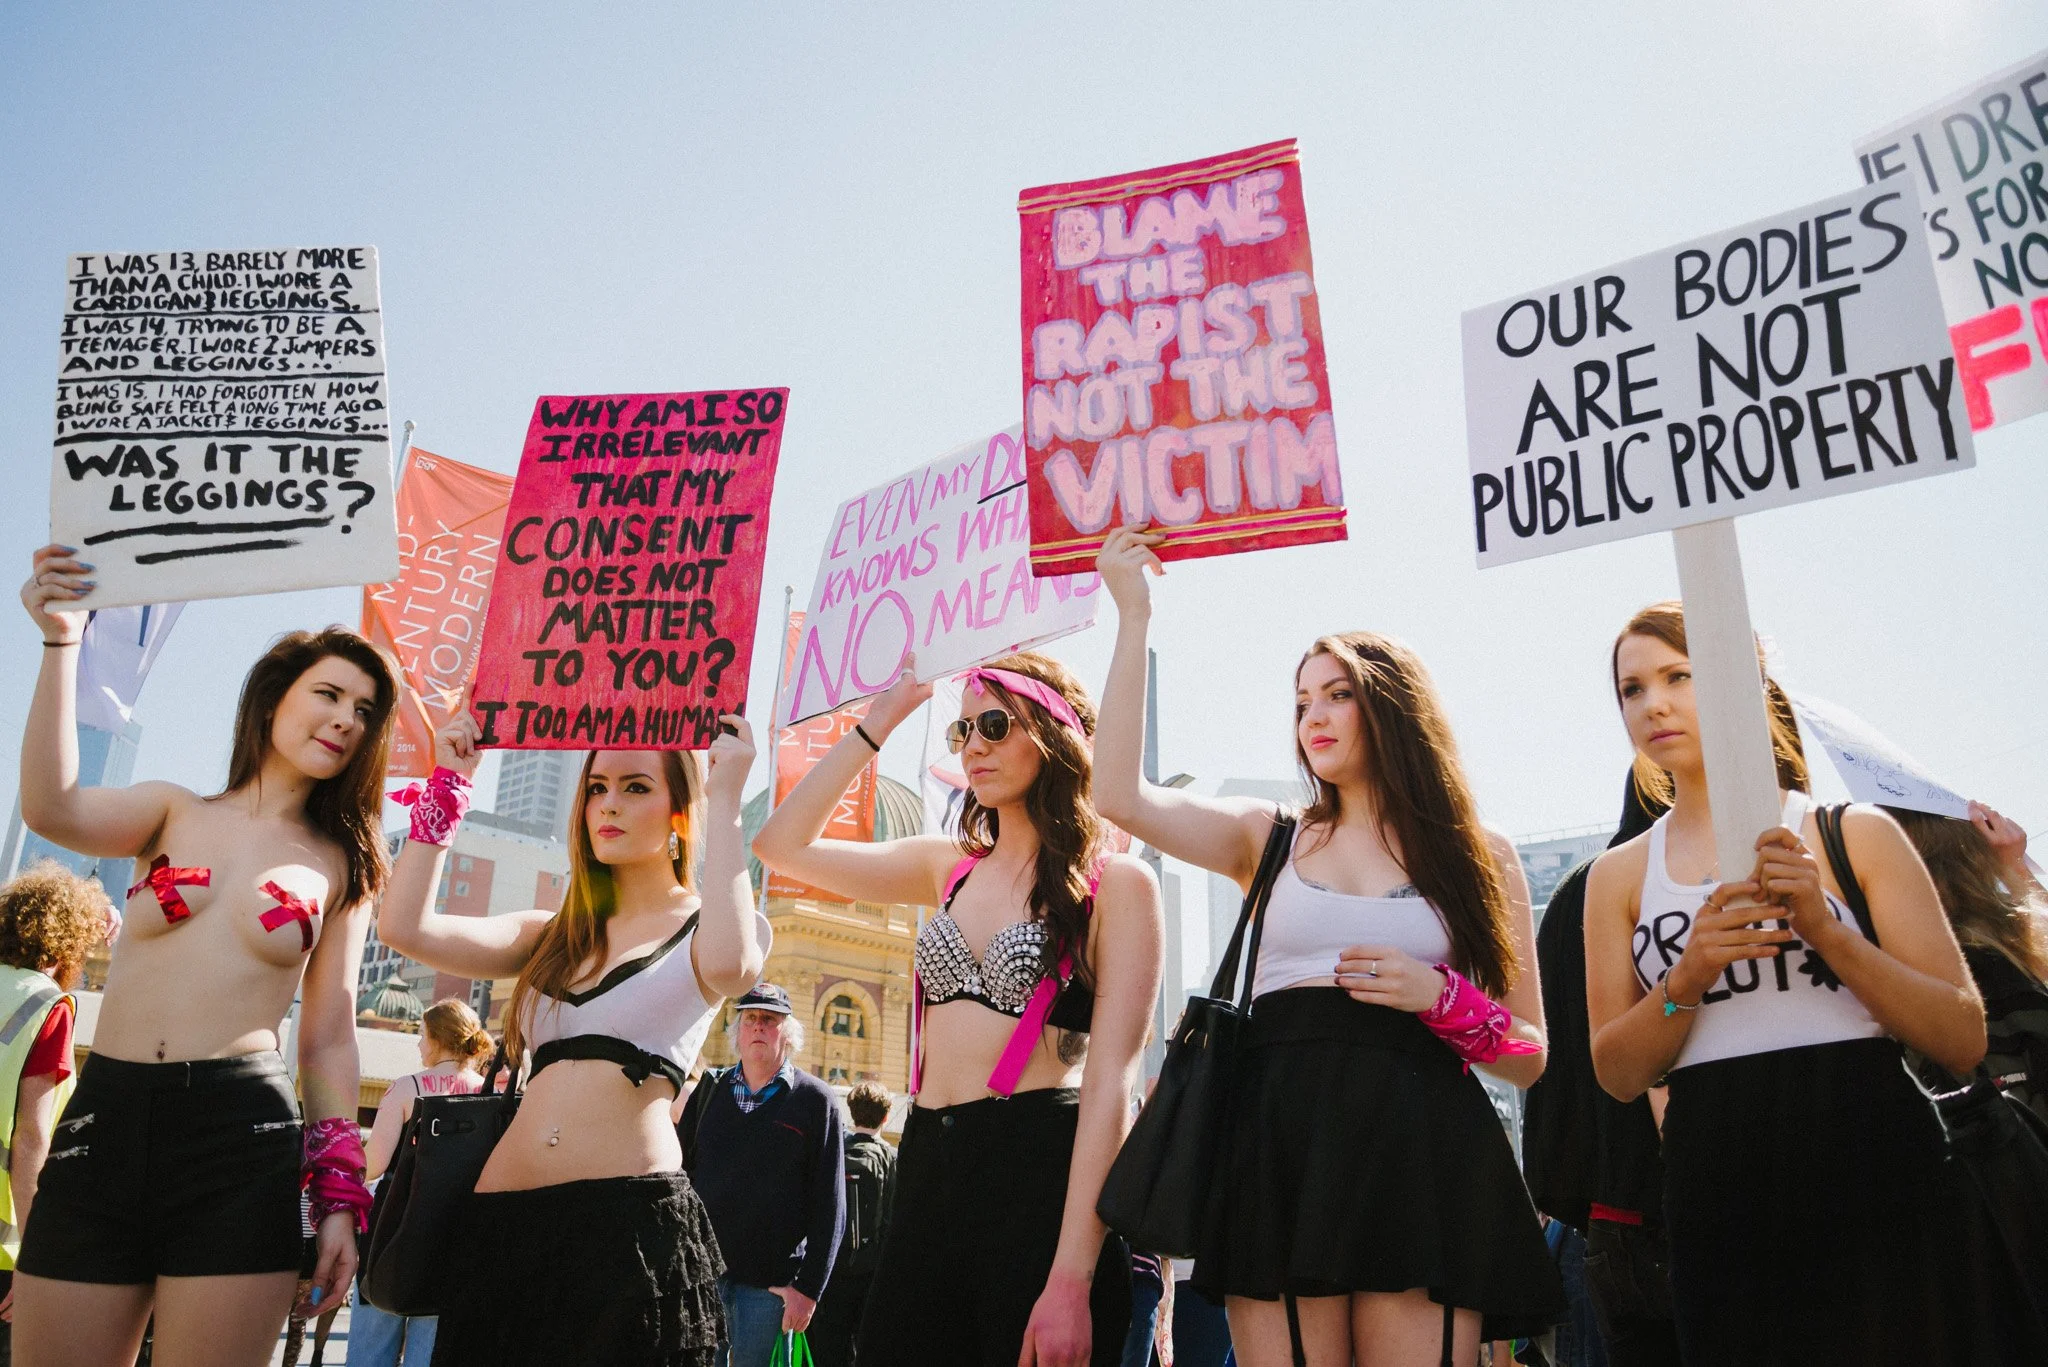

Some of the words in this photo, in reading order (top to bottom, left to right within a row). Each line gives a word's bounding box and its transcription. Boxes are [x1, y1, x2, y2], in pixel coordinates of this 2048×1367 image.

[1912, 132, 1940, 195] I
[1054, 168, 1288, 271] BLAME
[1965, 161, 2048, 246] FOR
[69, 276, 149, 297] THAN
[151, 273, 172, 293] A
[245, 273, 250, 289] I
[256, 271, 322, 289] WORE
[329, 272, 353, 289] A
[76, 256, 95, 277] I
[104, 254, 159, 274] WAS
[206, 251, 287, 271] BARELY
[296, 248, 366, 269] MORE
[1079, 247, 1206, 306] THE
[1496, 274, 1633, 358] OUR
[1675, 191, 1908, 321] BODIES
[61, 317, 78, 336] I
[84, 318, 134, 334] WAS
[261, 315, 290, 335] TO
[296, 315, 326, 335] BE
[334, 315, 367, 335] A
[73, 292, 201, 311] CARDIGAN
[1031, 271, 1315, 381] RAPIST
[63, 355, 140, 373] AND
[188, 337, 198, 354] I
[201, 337, 261, 354] WORE
[1516, 343, 1664, 456] ARE
[1696, 283, 1862, 409] NOT
[1948, 296, 2048, 432] F
[57, 386, 71, 401] I
[76, 383, 120, 399] WAS
[158, 384, 164, 398] I
[172, 384, 207, 399] HAD
[212, 382, 316, 400] FORGOTTEN
[327, 380, 379, 399] HOW
[57, 399, 123, 419] BEING
[130, 400, 174, 416] SAFE
[179, 399, 219, 414] FELT
[224, 401, 236, 414] A
[284, 401, 327, 416] TIME
[334, 398, 386, 415] AGO
[541, 399, 629, 428] WHY
[631, 396, 696, 427] AM
[697, 394, 728, 427] I
[733, 392, 783, 425] SO
[1027, 361, 1164, 451] NOT
[1170, 338, 1319, 421] THE
[57, 421, 64, 435] I
[71, 417, 131, 430] WORE
[136, 417, 152, 431] A
[156, 415, 222, 429] JACKET
[537, 428, 770, 463] IRRELEVANT
[64, 444, 180, 481] WAS
[204, 442, 252, 475] IT
[267, 443, 363, 478] THE
[1042, 411, 1344, 535] VICTIM
[1472, 431, 1654, 553] PUBLIC
[1667, 356, 1959, 508] PROPERTY
[571, 470, 673, 508] THAT
[671, 469, 736, 507] MY
[829, 466, 930, 560] EVEN
[929, 454, 981, 510] MY
[505, 513, 754, 566] CONSENT
[543, 565, 637, 599] DOES
[645, 558, 728, 595] NOT
[818, 523, 941, 613] KNOWS
[394, 519, 464, 691] NTURY
[420, 533, 501, 710] MODERN
[537, 599, 717, 645] MATTER
[522, 649, 585, 687] TO
[606, 638, 736, 698] YOU?
[789, 588, 915, 722] NO
[475, 701, 508, 745] I
[571, 702, 613, 744] AM
[613, 703, 638, 745] A
